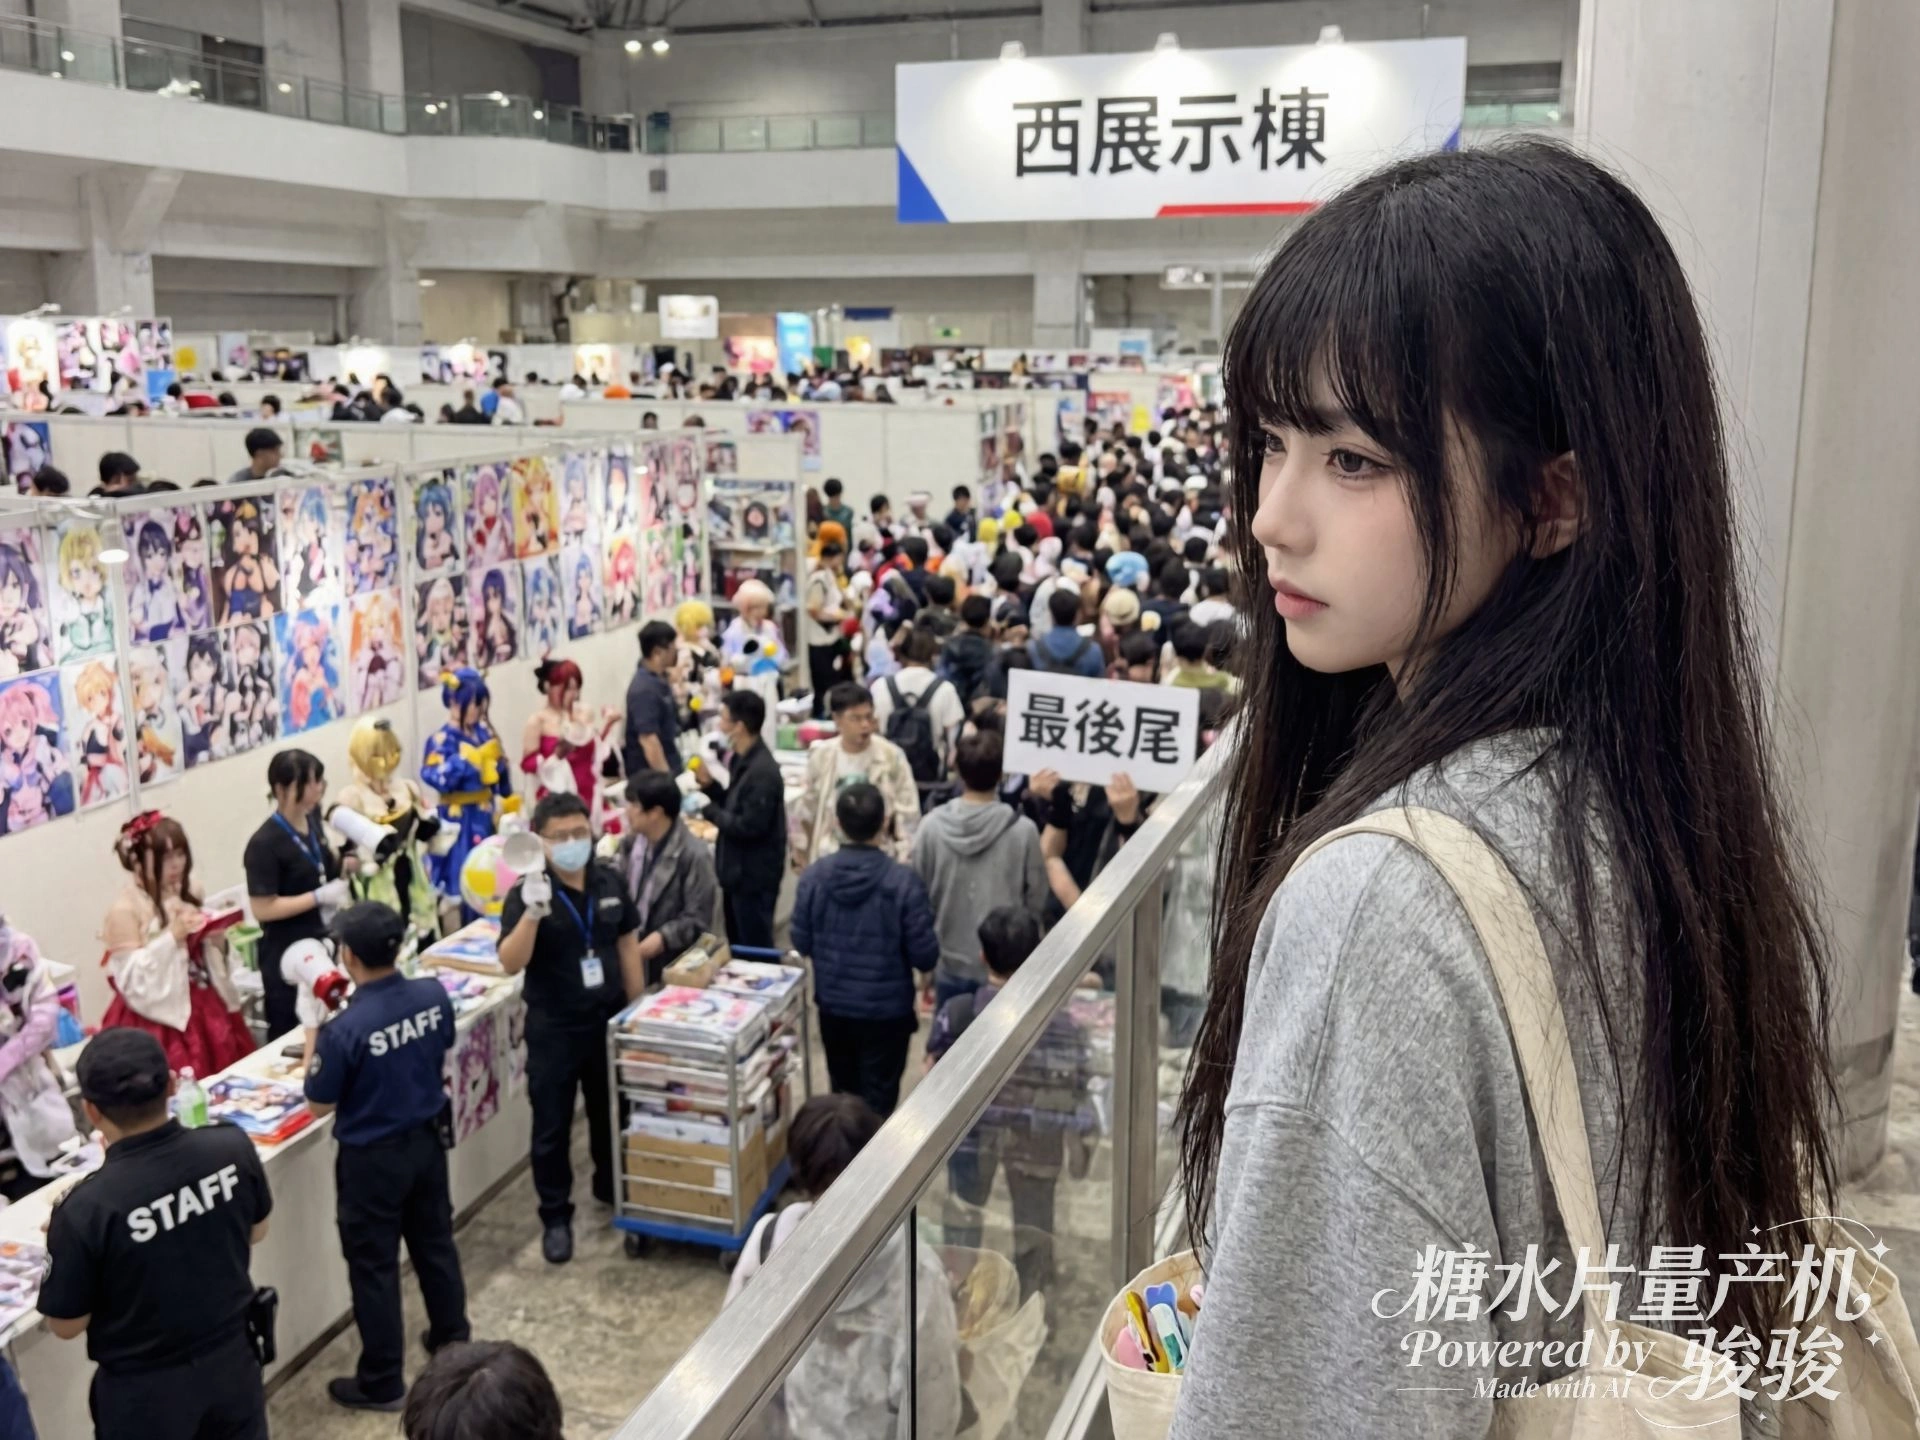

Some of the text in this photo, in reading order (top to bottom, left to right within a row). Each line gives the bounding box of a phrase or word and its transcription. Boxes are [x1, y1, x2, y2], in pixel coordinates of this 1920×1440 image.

[1012, 86, 1329, 177] 西展示棟
[1019, 692, 1180, 764] 最後尾
[368, 1005, 443, 1056] STAFF
[127, 1163, 239, 1243] STAFF
